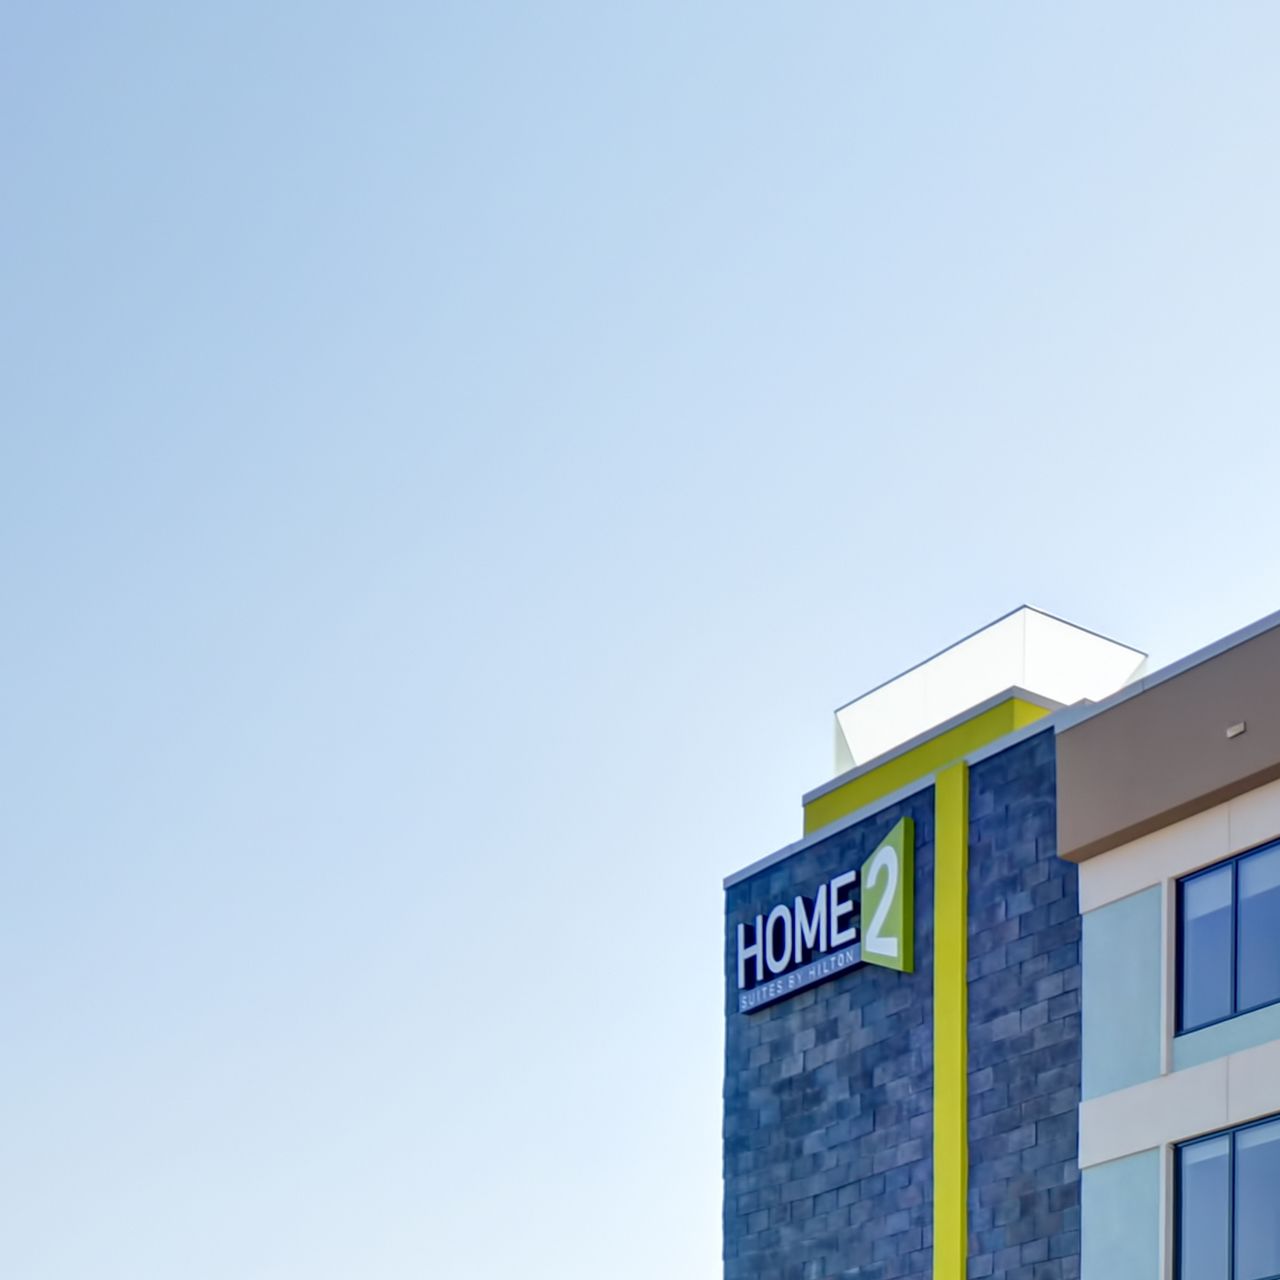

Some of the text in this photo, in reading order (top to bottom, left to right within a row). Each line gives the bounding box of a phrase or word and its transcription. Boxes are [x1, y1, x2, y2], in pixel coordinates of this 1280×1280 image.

[737, 844, 899, 989] HOME 2
[740, 949, 855, 1009] SUITES BY HILTON
